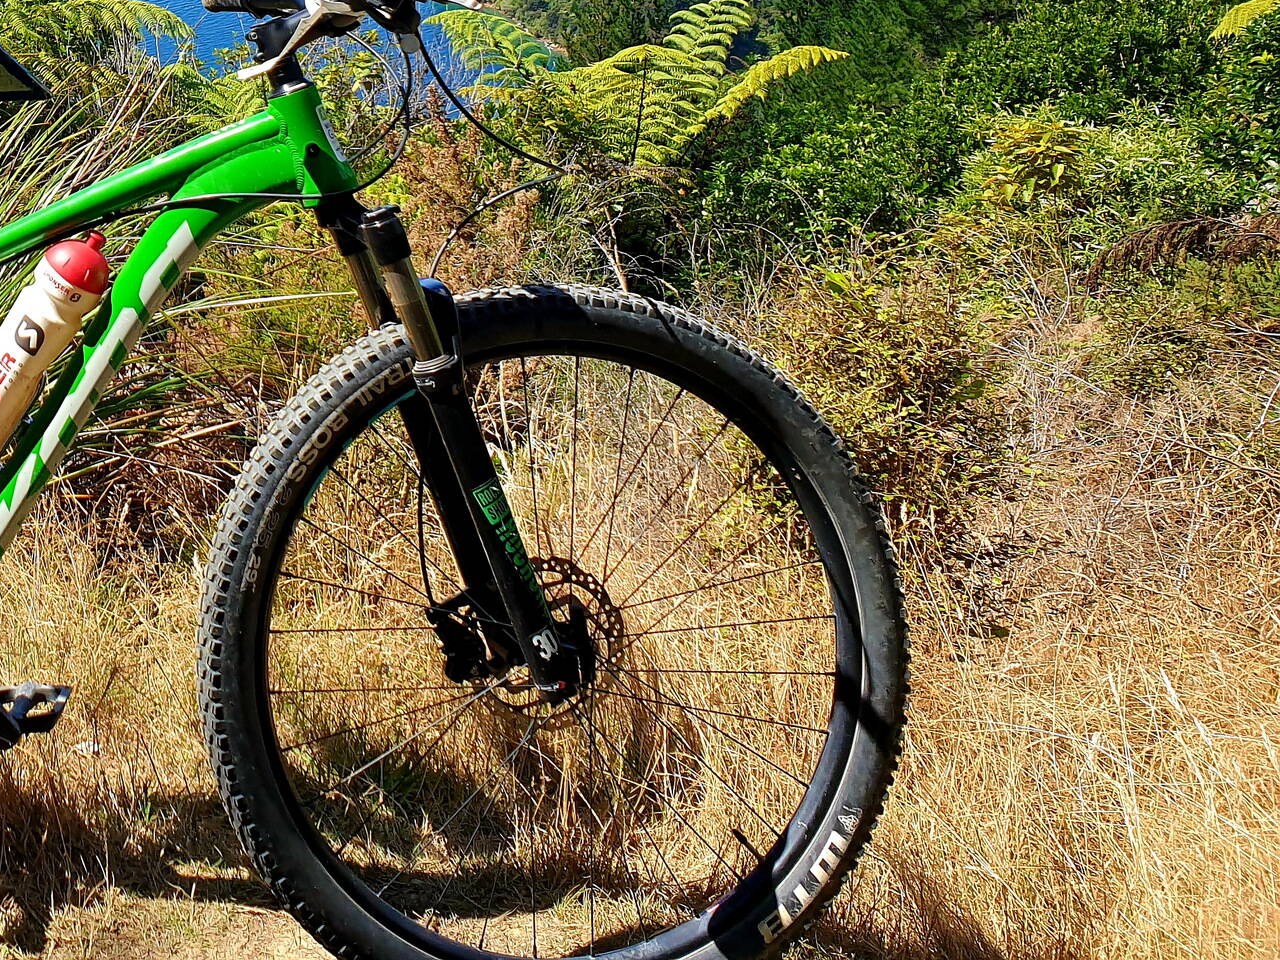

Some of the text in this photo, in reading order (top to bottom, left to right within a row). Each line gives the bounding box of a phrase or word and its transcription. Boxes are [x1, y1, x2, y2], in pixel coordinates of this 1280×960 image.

[287, 410, 350, 483] BOSS
[487, 498, 510, 521] SHO
[532, 629, 559, 661] 30
